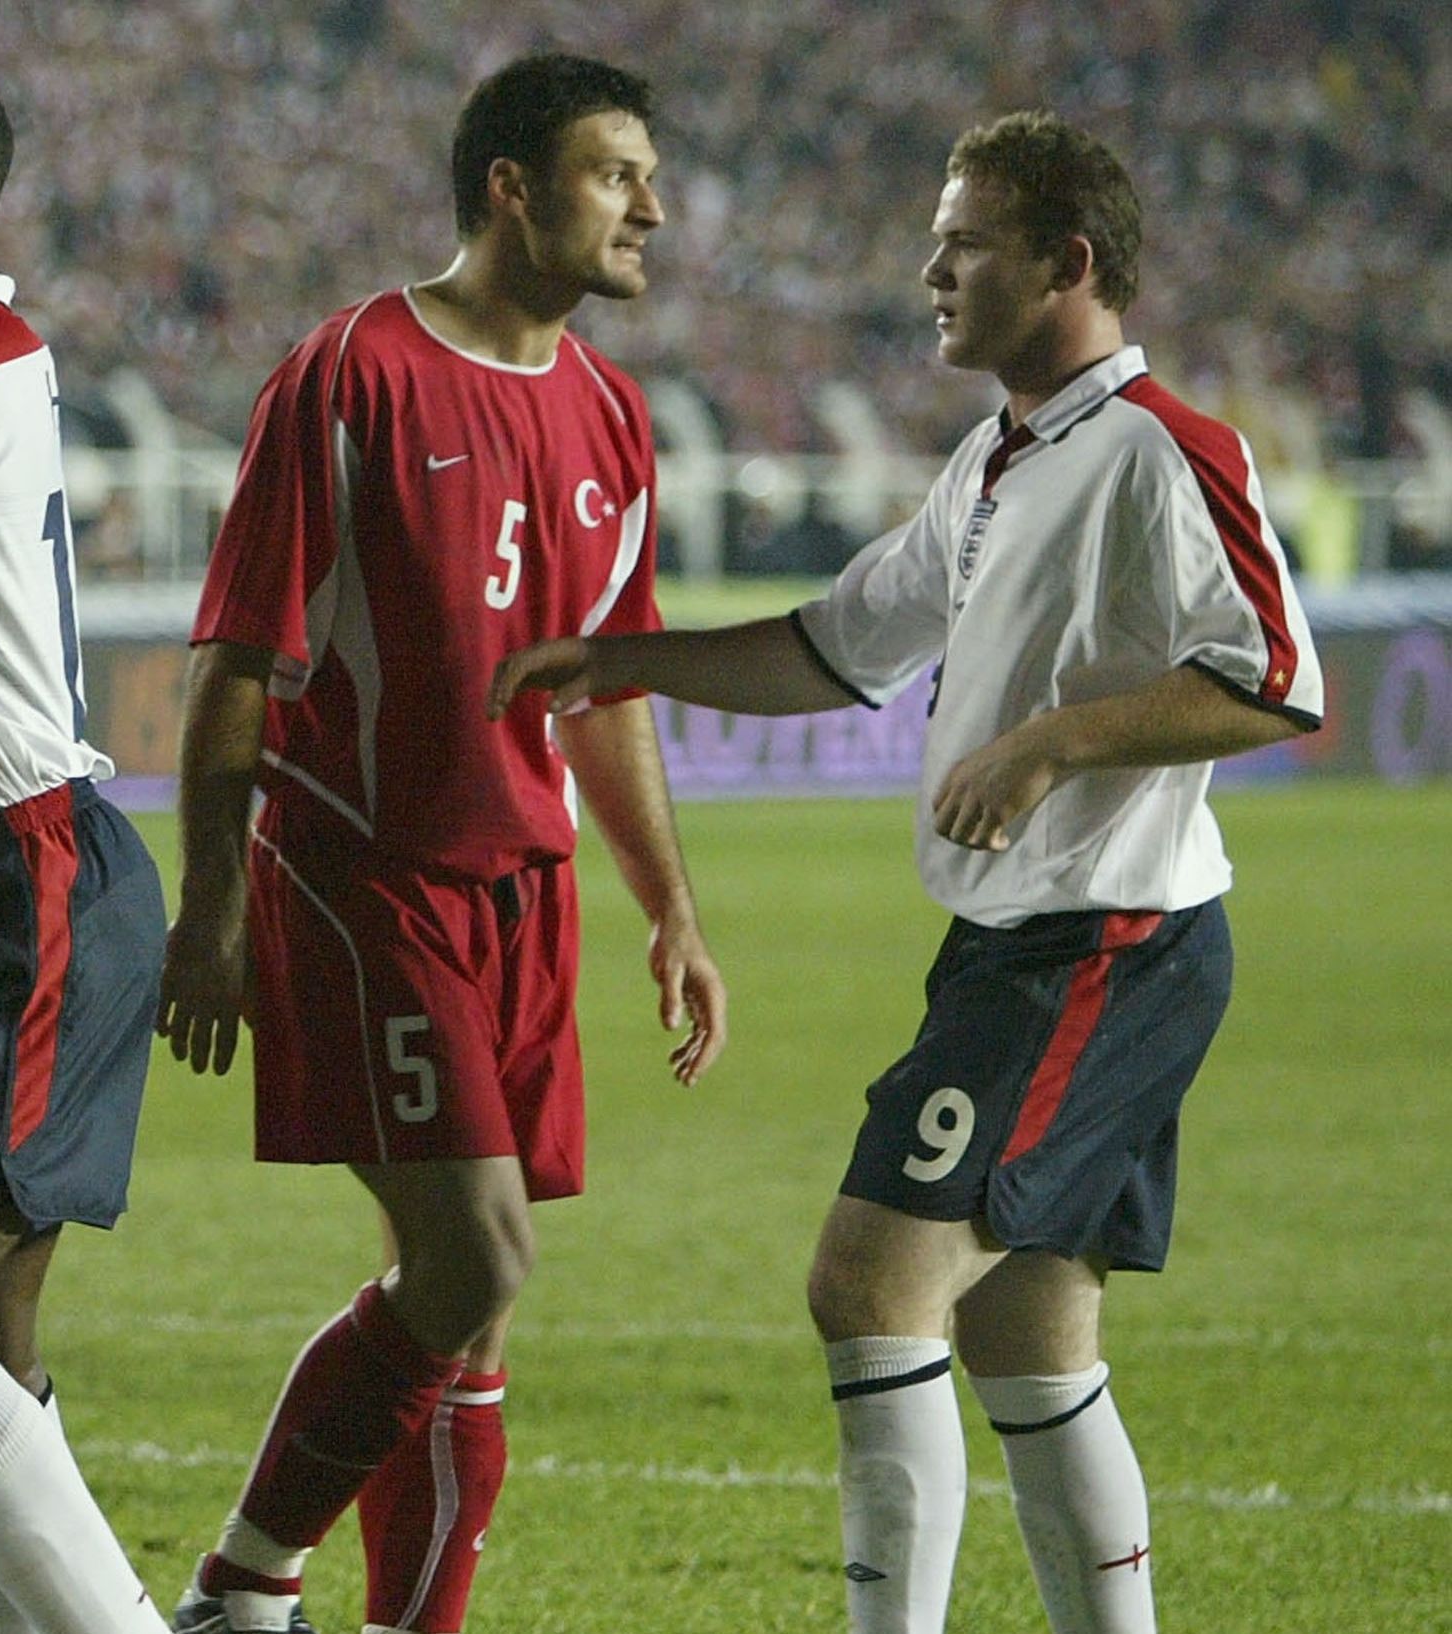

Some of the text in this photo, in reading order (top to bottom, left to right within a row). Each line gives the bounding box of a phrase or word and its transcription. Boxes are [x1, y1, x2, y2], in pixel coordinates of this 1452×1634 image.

[485, 499, 527, 610] 5
[41, 489, 88, 743] 1
[386, 1015, 437, 1122] 5
[902, 1087, 975, 1182] 9
